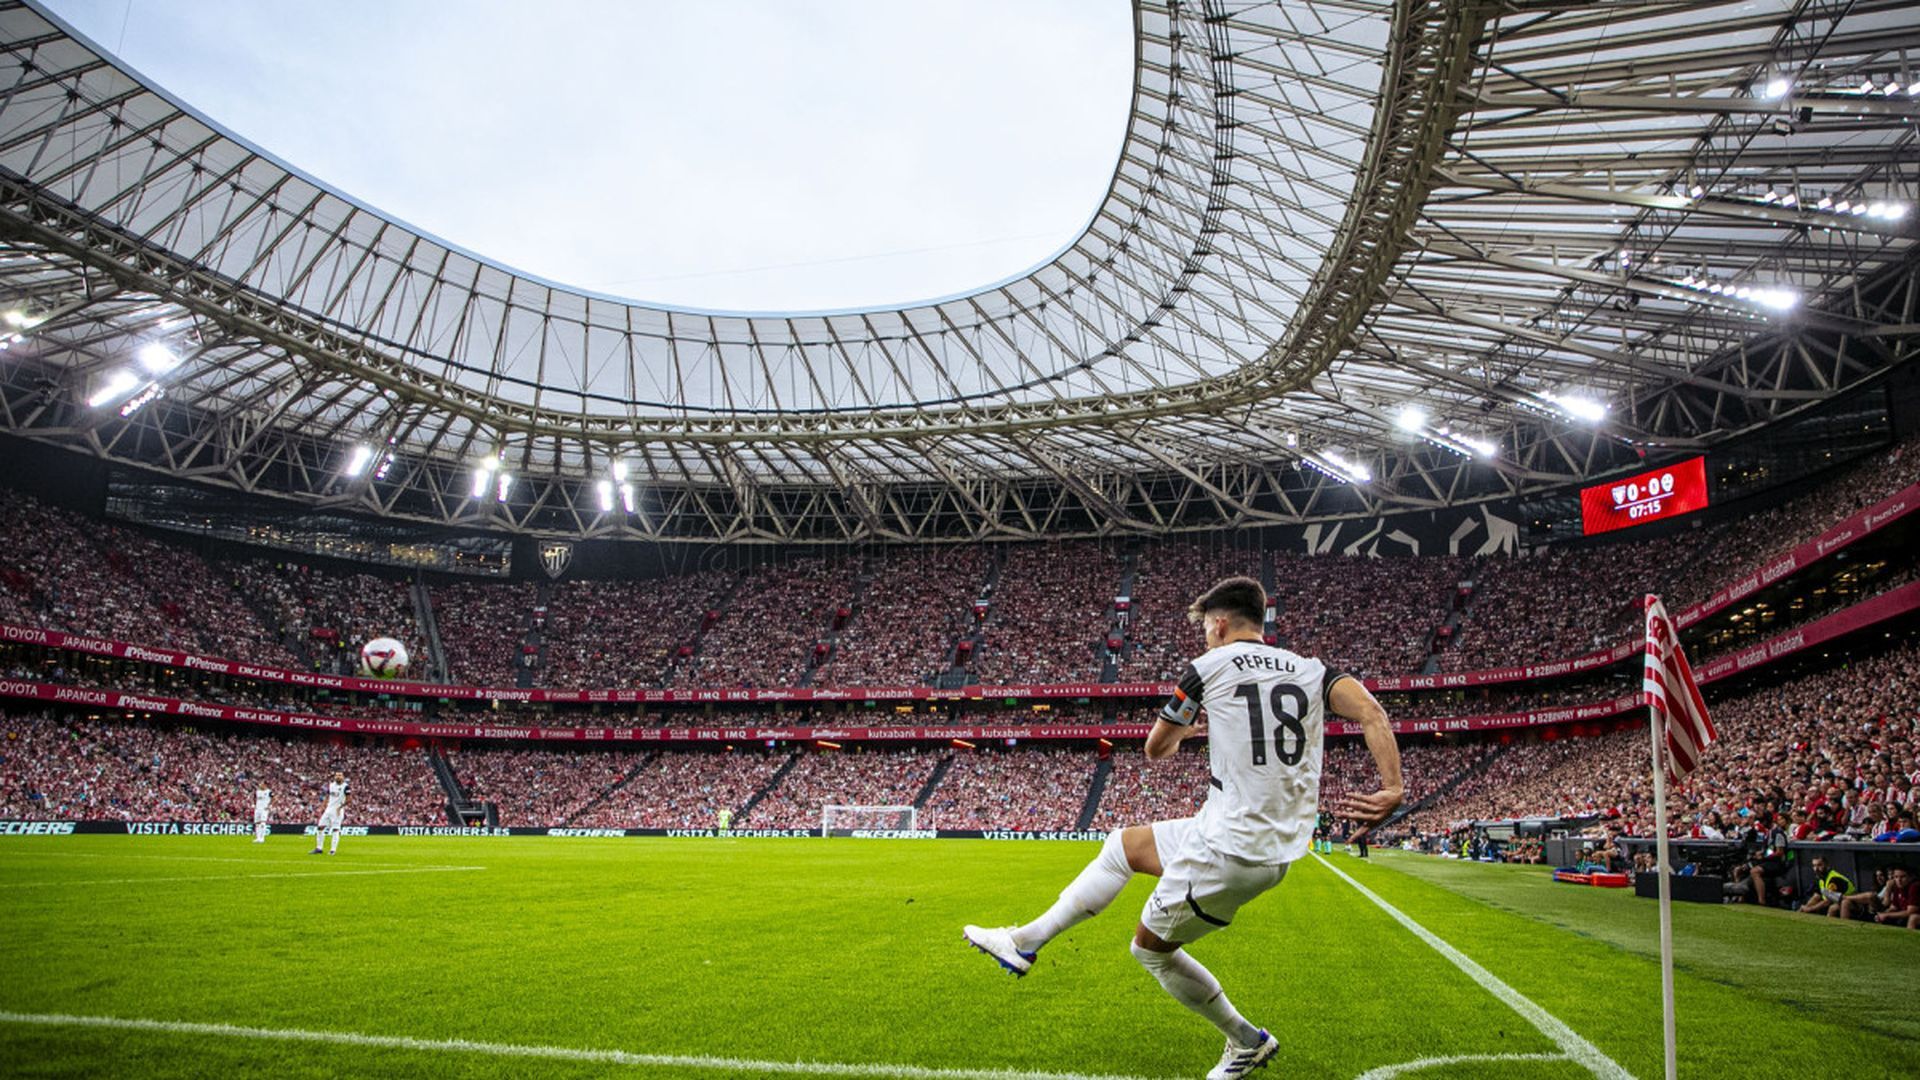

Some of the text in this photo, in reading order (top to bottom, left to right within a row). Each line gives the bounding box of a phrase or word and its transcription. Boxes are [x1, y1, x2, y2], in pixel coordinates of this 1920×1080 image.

[1627, 483, 1639, 501] 0
[1648, 477, 1660, 495] 0
[1629, 500, 1661, 518] 07:15
[3, 626, 113, 653] TOYOTA JAPANCAR
[137, 648, 174, 664] Petronor
[195, 657, 229, 673] Petronor
[1231, 653, 1296, 674] PEPELU
[1410, 679, 1435, 687] IMQ
[1444, 675, 1467, 685] IMQ
[0, 681, 107, 704] OYOTA JAPANCAR
[485, 691, 532, 701] B2BINPAY
[699, 691, 719, 700] IMQ
[728, 691, 749, 700] IMQ
[865, 689, 914, 698] kutxabank
[982, 688, 1032, 697] kutxabank
[130, 697, 168, 712] Petronor
[189, 703, 223, 718] Petronor
[1233, 683, 1309, 767] 18
[1414, 721, 1439, 731] IMQ
[1446, 720, 1469, 729] IMQ
[484, 729, 531, 739] B2BINPAY
[697, 731, 719, 739] IMQ
[725, 731, 747, 739] IMQ
[868, 729, 916, 739] kutxabank
[924, 729, 974, 738] kutxabank
[981, 729, 1031, 738] kutxabank
[0, 822, 76, 834] ECHERS
[127, 823, 271, 835] VISITA SKECHERS.S
[398, 826, 510, 836] VISITA SKECHERS.ES
[547, 828, 627, 837] SKECHERS
[666, 829, 714, 837] VISITA
[851, 830, 938, 838] SKECHERS
[983, 831, 1108, 841] VISITA SKECHER
